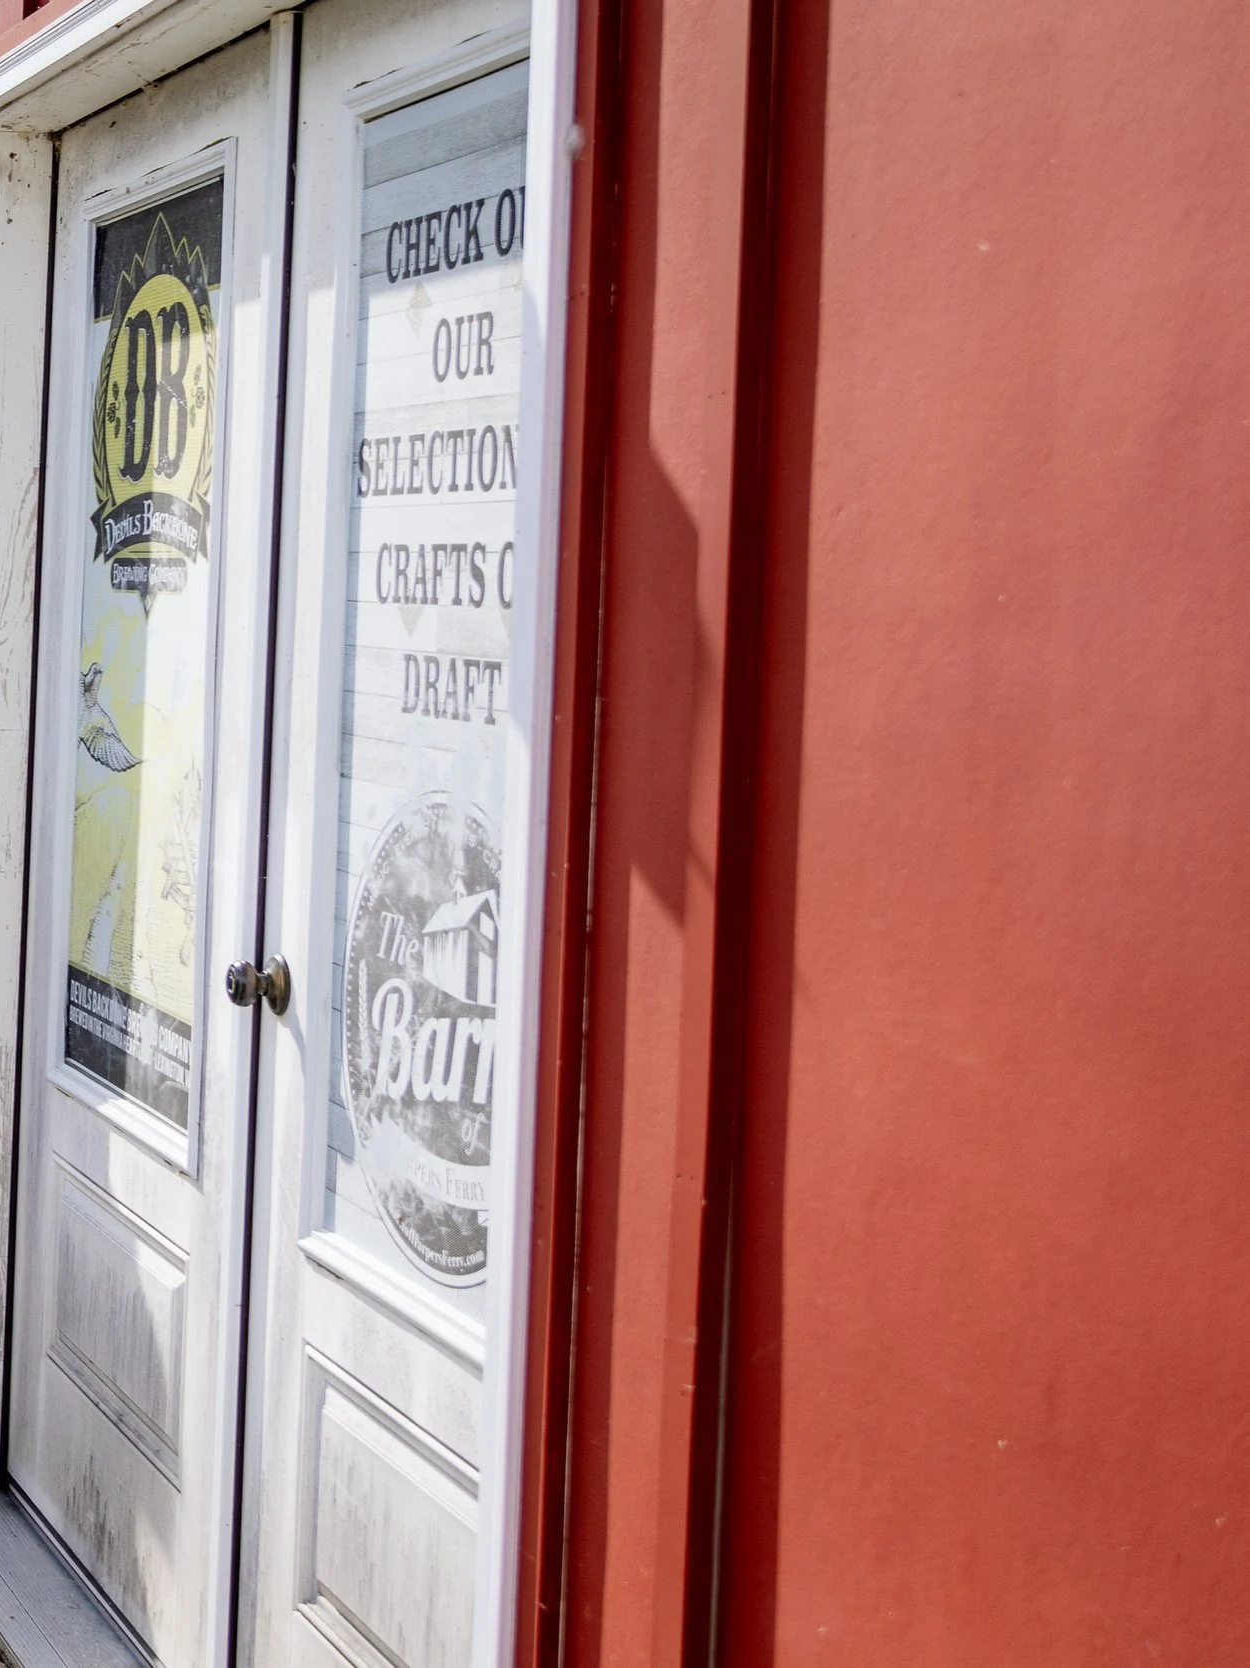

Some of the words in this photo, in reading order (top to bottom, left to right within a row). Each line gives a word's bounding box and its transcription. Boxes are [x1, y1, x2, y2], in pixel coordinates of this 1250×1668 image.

[385, 197, 486, 284] CHECK
[432, 311, 495, 384] OUR
[117, 301, 191, 485] DB
[356, 424, 520, 499] SELECTION
[375, 541, 487, 609] CRAFTS
[400, 653, 502, 727] DRAFT
[376, 911, 420, 966] The
[92, 990, 127, 1030] BACKE
